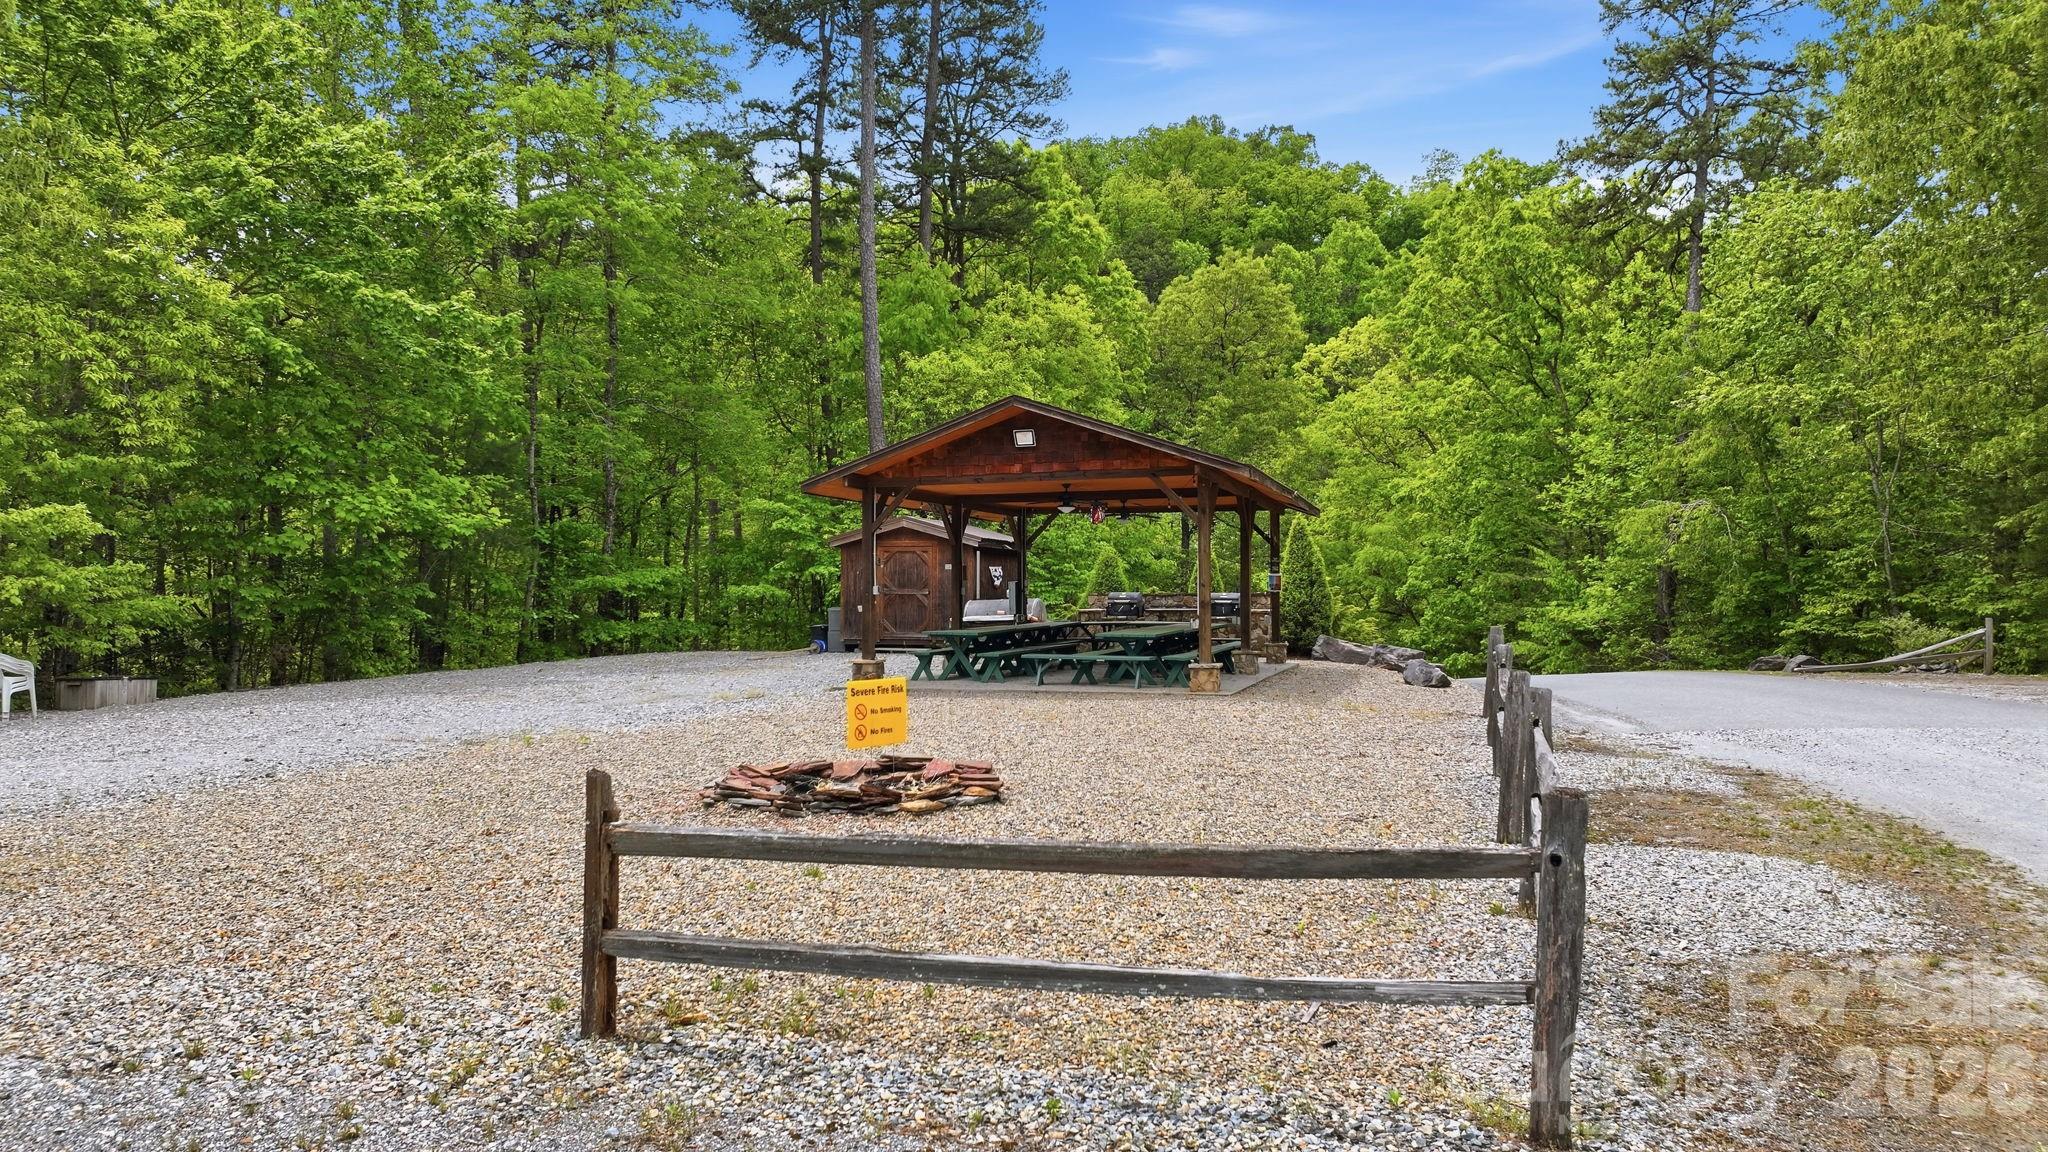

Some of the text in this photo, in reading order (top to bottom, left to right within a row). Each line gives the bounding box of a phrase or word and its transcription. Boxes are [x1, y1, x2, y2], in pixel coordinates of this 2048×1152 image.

[850, 684, 904, 697] Severe Fire Risk
